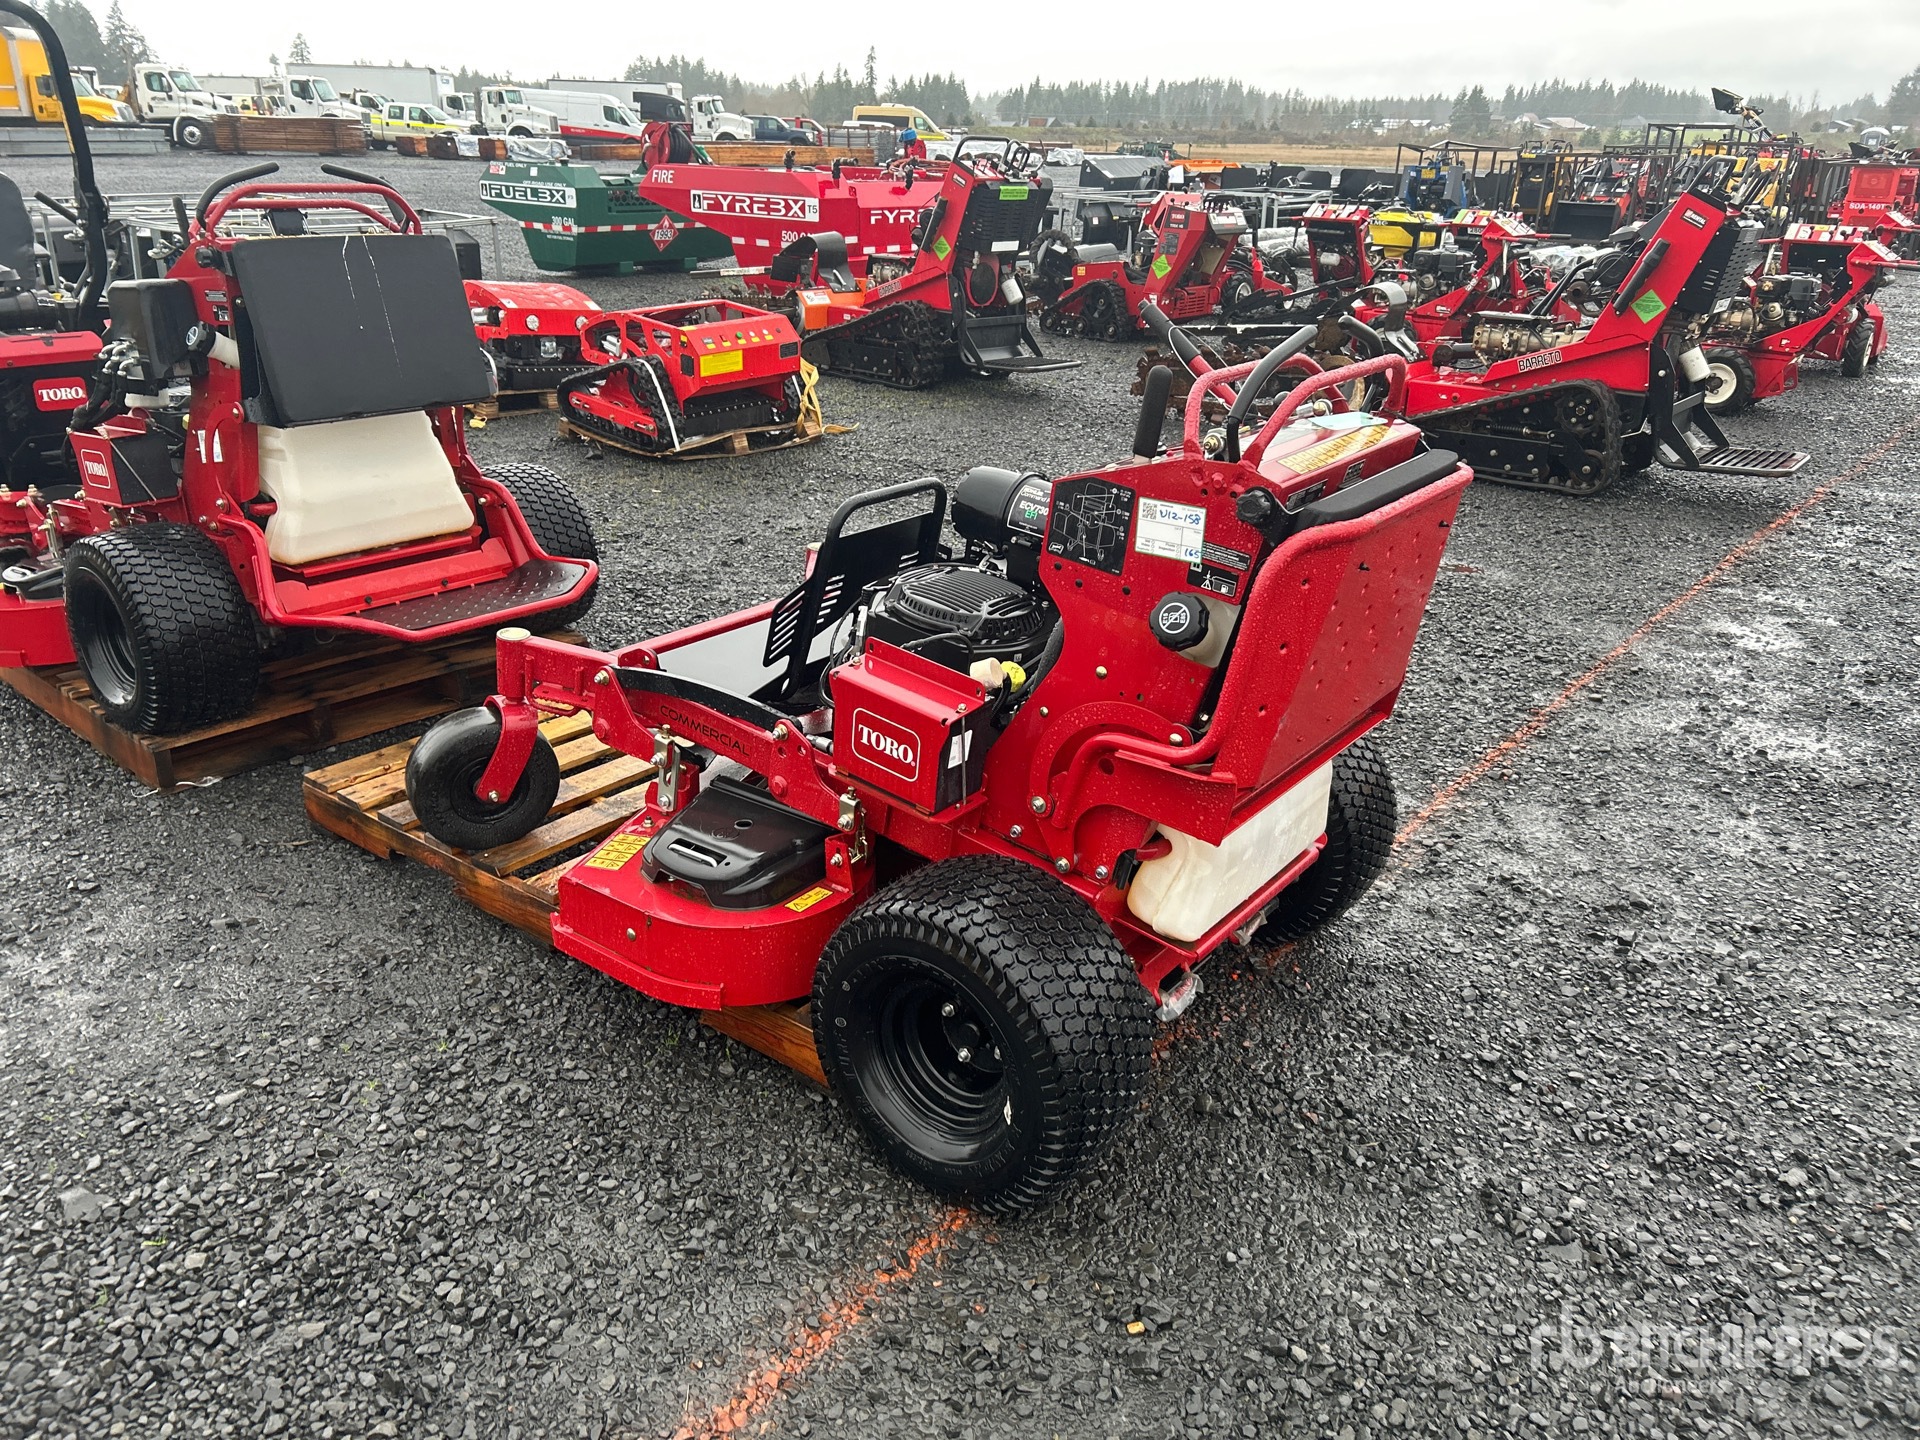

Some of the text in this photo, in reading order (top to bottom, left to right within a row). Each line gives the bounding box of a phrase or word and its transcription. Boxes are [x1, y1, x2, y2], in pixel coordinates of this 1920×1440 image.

[652, 169, 675, 184] FIRE
[807, 204, 818, 214] T5
[551, 216, 575, 227] 300 GAL
[655, 229, 673, 239] 1993
[781, 230, 798, 242] 500
[1517, 350, 1562, 372] BARRETO
[38, 386, 84, 402] TORO
[84, 461, 107, 477] TORO
[1019, 500, 1050, 516] ECV730
[1025, 510, 1038, 521] EFI
[660, 705, 750, 757] COMMERCIAL
[858, 723, 914, 764] TORO
